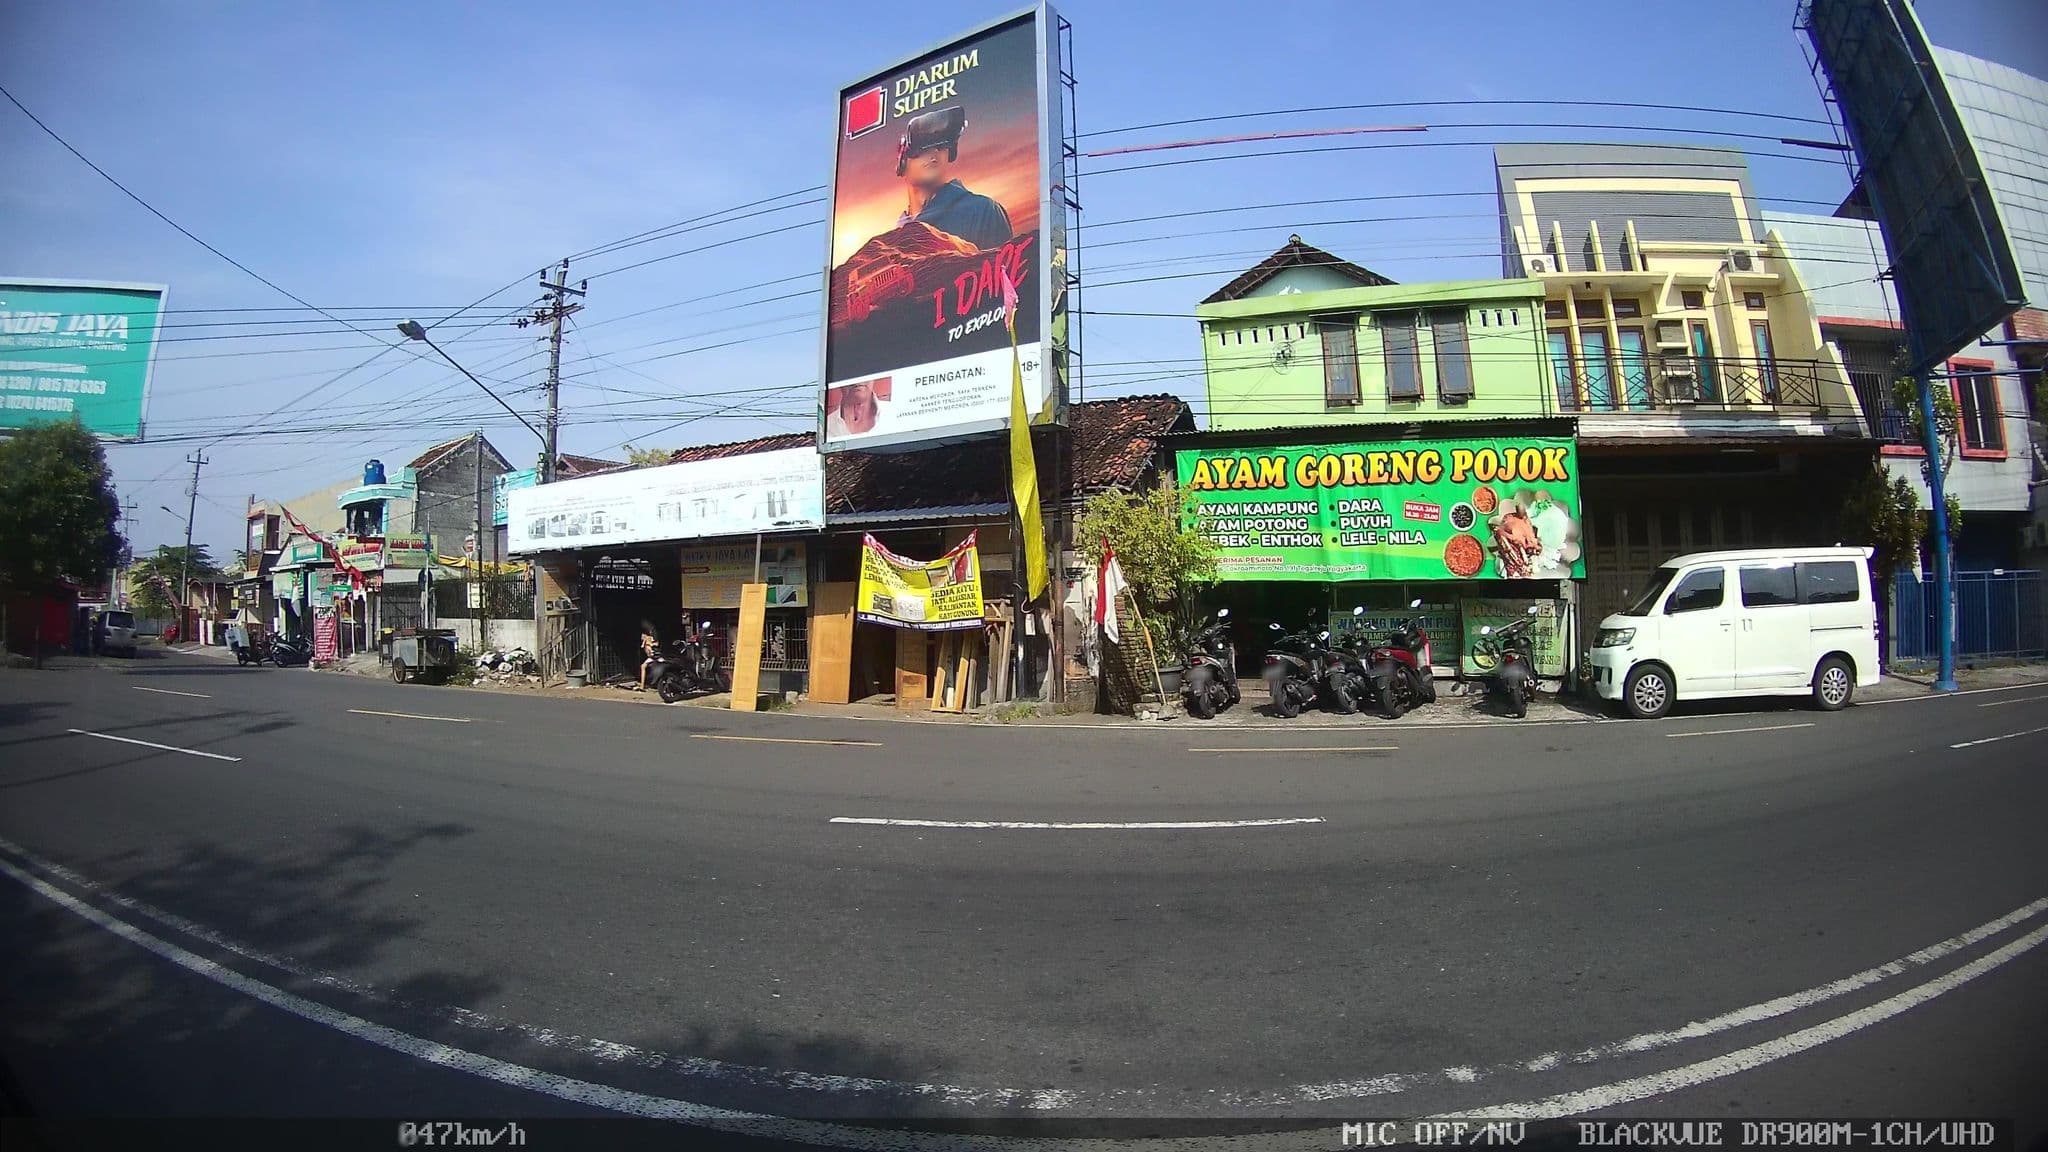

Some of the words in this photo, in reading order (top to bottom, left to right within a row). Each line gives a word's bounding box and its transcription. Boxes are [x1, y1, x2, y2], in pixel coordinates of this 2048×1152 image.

[895, 49, 980, 98] DJARUM
[893, 79, 958, 119] SUPER
[933, 287, 946, 329] I
[953, 235, 1034, 317] DARE
[60, 313, 129, 340] JAYA
[948, 323, 964, 343] TO
[965, 299, 1018, 335] EXPLO
[1021, 361, 1041, 372] 18+
[915, 366, 986, 387] PERINGATAN:
[1192, 456, 1287, 490] AYAM
[1295, 450, 1442, 488] GORENG
[1451, 447, 1568, 482] POJOK
[1197, 503, 1239, 516] AYAM
[1243, 502, 1318, 515] KAMPUNG
[1339, 499, 1382, 513] DARA
[1245, 518, 1308, 531] POTONG
[1341, 515, 1392, 529] PUYUH
[1262, 534, 1322, 546] ENTHOK
[1342, 532, 1377, 546] LELE
[1389, 531, 1426, 544] NILA
[1245, 556, 1283, 564] PESANAN
